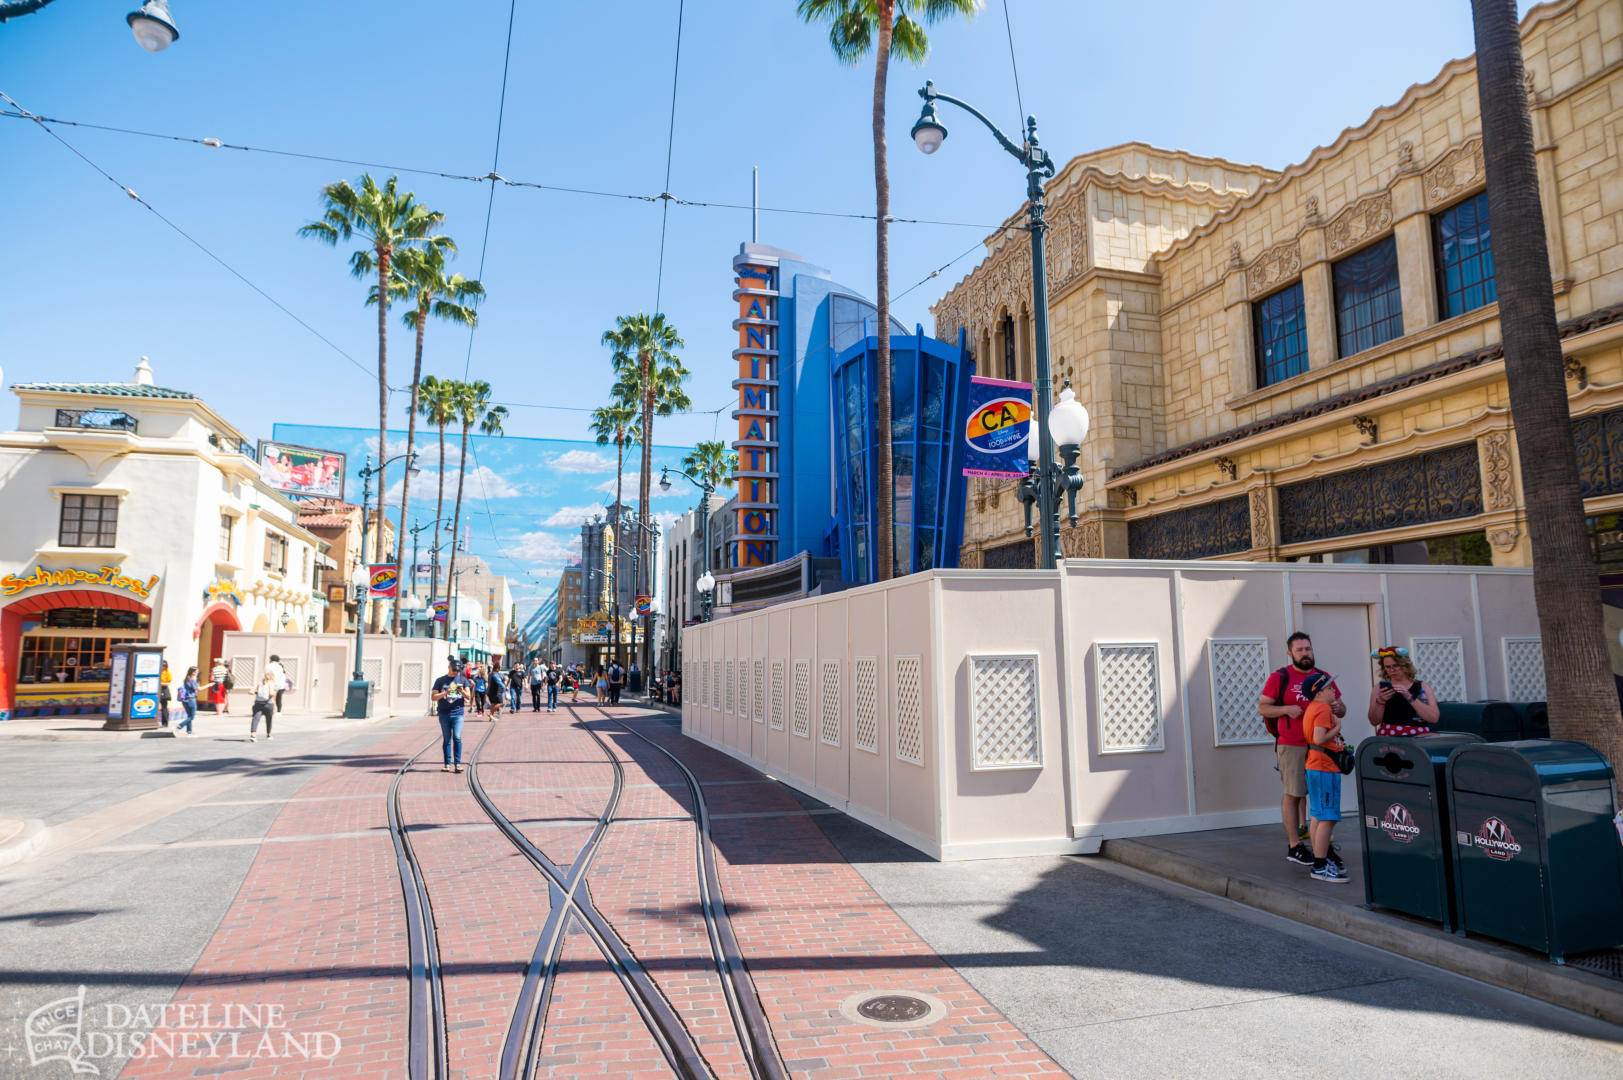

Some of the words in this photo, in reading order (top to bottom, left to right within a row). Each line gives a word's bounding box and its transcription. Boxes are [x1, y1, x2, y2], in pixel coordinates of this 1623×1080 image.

[981, 405, 1018, 431] CA
[744, 298, 767, 565] ANIMATION
[375, 572, 392, 583] CA
[1381, 820, 1420, 834] HOLLYWOOD
[1474, 835, 1521, 851] HOLLYWOOD
